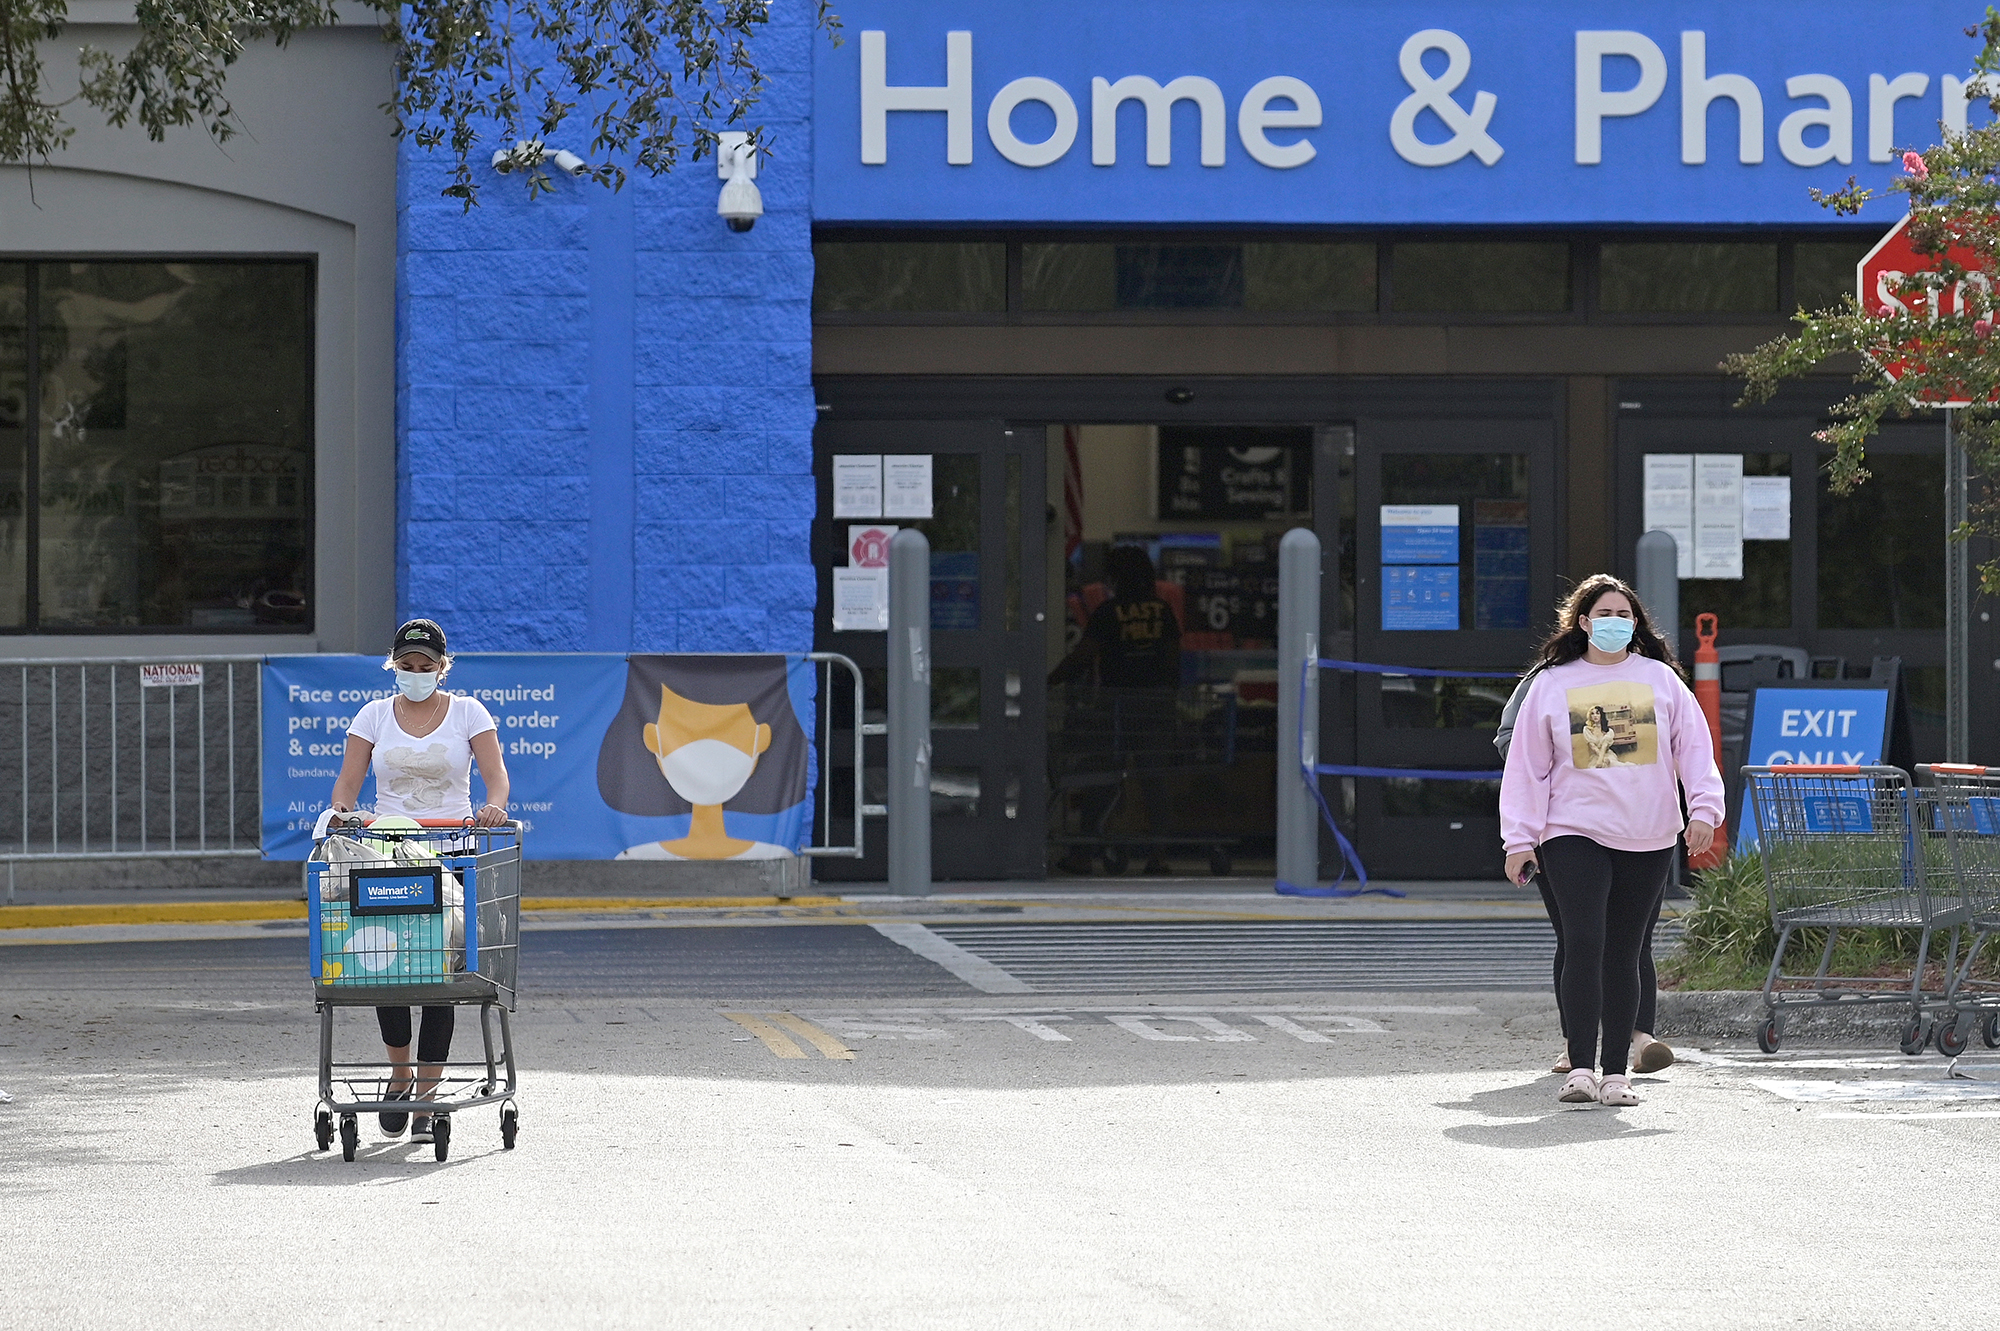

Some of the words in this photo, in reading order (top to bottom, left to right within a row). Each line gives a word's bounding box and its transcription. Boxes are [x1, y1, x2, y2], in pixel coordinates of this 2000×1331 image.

[860, 29, 1322, 168] Home
[1389, 28, 1505, 168] &
[1115, 602, 1164, 621] LAST
[143, 664, 200, 676] NATIONAL
[288, 685, 333, 702] Face
[473, 684, 555, 706] required
[288, 716, 321, 734] per
[505, 710, 560, 728] order
[1781, 709, 1858, 737] EXIT
[288, 738, 303, 756] &
[510, 737, 557, 759] shop
[288, 801, 304, 813] All
[308, 801, 323, 813] of
[521, 801, 553, 812] wear
[287, 822, 296, 831] a
[367, 885, 408, 896] Walmart
